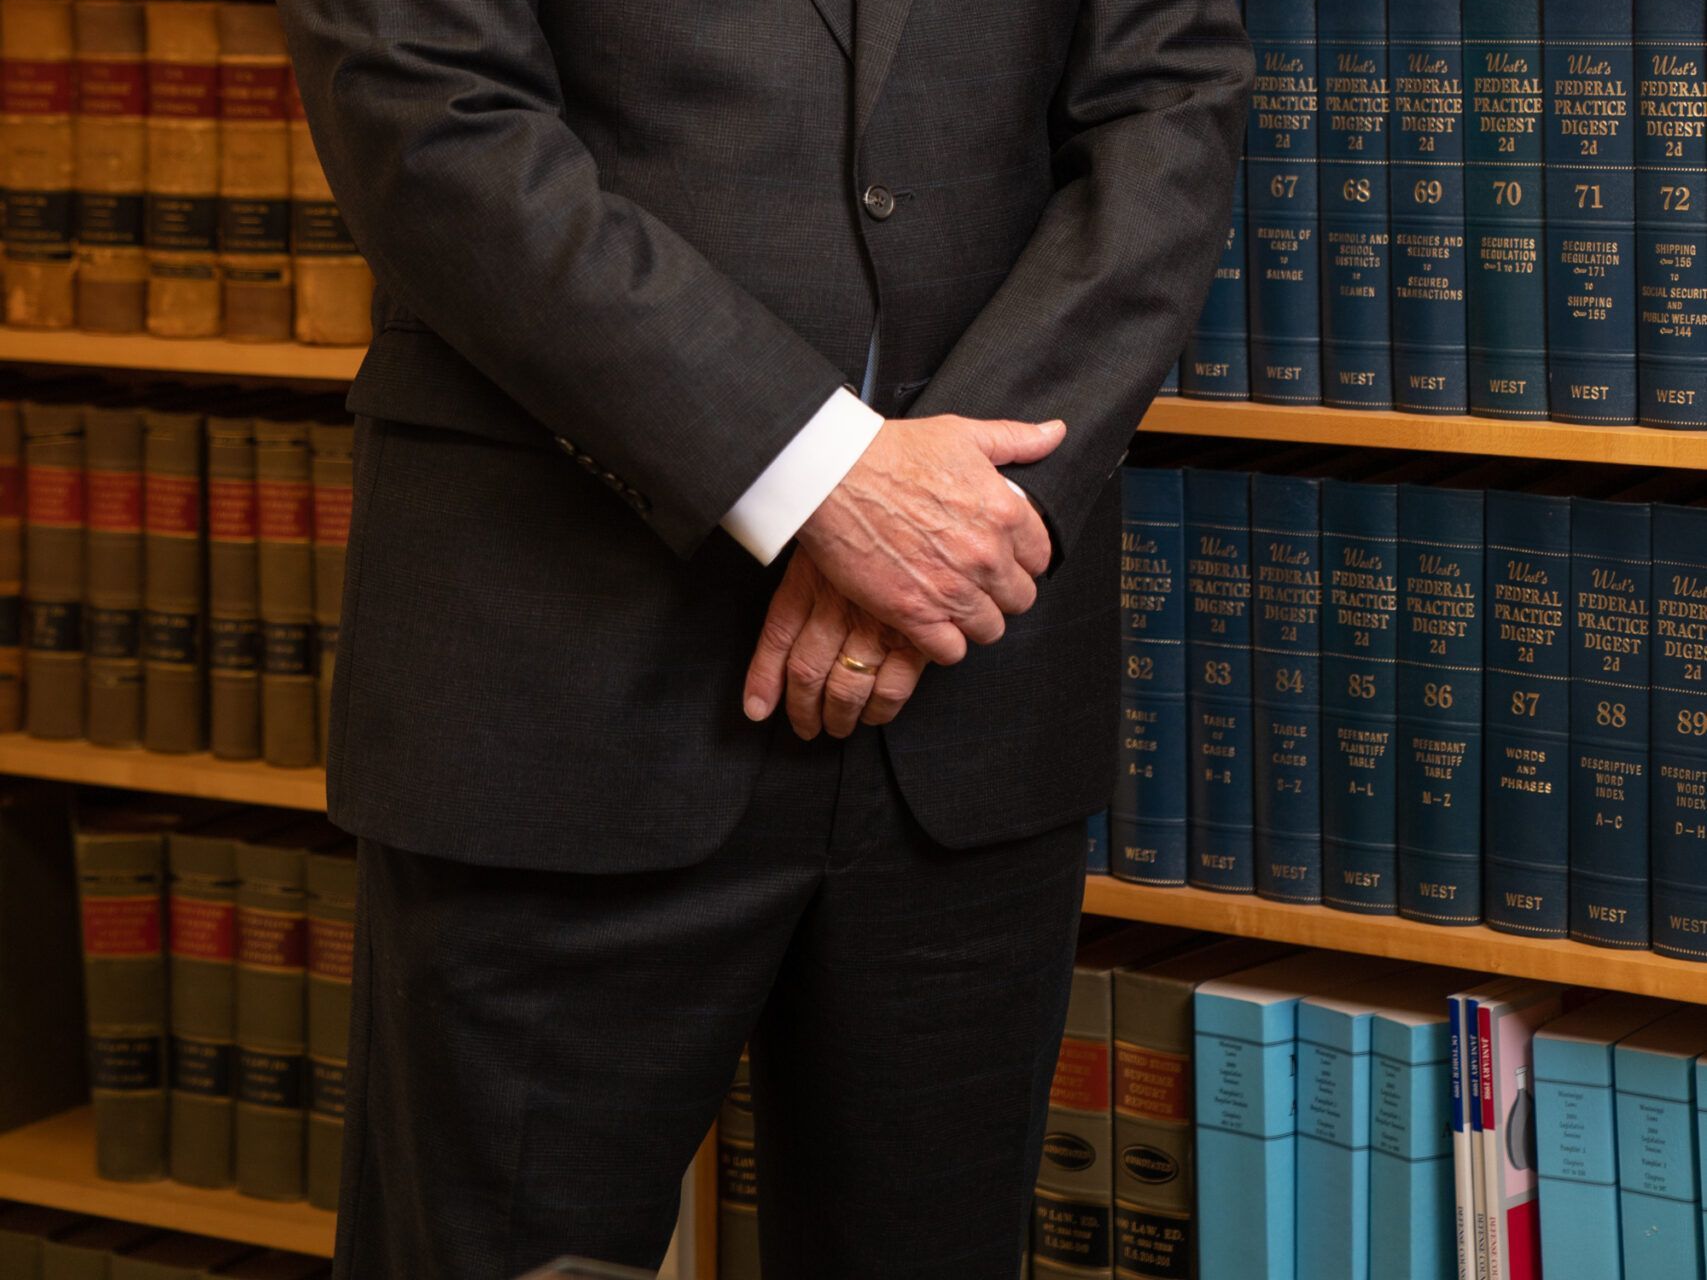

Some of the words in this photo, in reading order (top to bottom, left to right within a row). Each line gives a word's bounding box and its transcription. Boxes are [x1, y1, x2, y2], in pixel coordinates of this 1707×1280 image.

[1568, 55, 1611, 75] West's
[1555, 80, 1626, 96] FEDERAL
[1554, 100, 1627, 116] PRACTICE
[1561, 120, 1618, 136] DIGEST
[1580, 140, 1597, 155] 2d
[1270, 176, 1298, 198] 67
[1343, 179, 1370, 202] 68
[1415, 180, 1442, 204] 69
[1493, 181, 1521, 206] 70
[1575, 184, 1603, 209] 71
[1660, 187, 1691, 211] 72
[1397, 234, 1438, 246] SEARCHES
[1443, 236, 1463, 247] AND
[1562, 241, 1617, 253] SECURITIES
[1407, 247, 1449, 258] SEIZURES
[1655, 244, 1696, 256] SHIPPING
[1561, 253, 1619, 266] REGULATION
[1675, 256, 1692, 267] 156
[1588, 266, 1605, 277] 171
[1408, 276, 1448, 288] SECURED
[1397, 287, 1463, 300] TRANSACTIONS
[1568, 296, 1612, 309] SHIPPING
[1588, 309, 1606, 320] 155
[1490, 380, 1526, 394] WEST
[1571, 385, 1609, 400] WEST
[1657, 390, 1695, 404] WEST
[1508, 560, 1548, 584] West's
[1495, 584, 1561, 607] FEDERAL
[1495, 604, 1562, 627] PRACTICE
[1501, 625, 1555, 645] DIGEST
[1518, 648, 1534, 663] 2d
[1127, 657, 1153, 680] 82
[1205, 662, 1232, 685] 83
[1276, 670, 1304, 693] 84
[1348, 675, 1375, 699] 85
[1424, 684, 1452, 708] 86
[1512, 692, 1540, 716] 87
[1597, 701, 1626, 727] 88
[1677, 710, 1706, 735] 89
[1413, 738, 1466, 754] DEFENDANT
[1416, 752, 1463, 766] PLAINTIFF
[1506, 748, 1546, 763] WORDS
[1424, 766, 1452, 780] TABLE
[1516, 764, 1536, 776] AND
[1581, 757, 1642, 776] DESCRIPTIVE
[1501, 777, 1552, 793] PHRASES
[1596, 773, 1623, 787] WORD
[1595, 787, 1625, 801] INDEX
[1420, 884, 1456, 899] WEST
[1506, 893, 1542, 910] WEST
[1589, 905, 1626, 923] WEST
[1481, 1037, 1490, 1084] JANUARY
